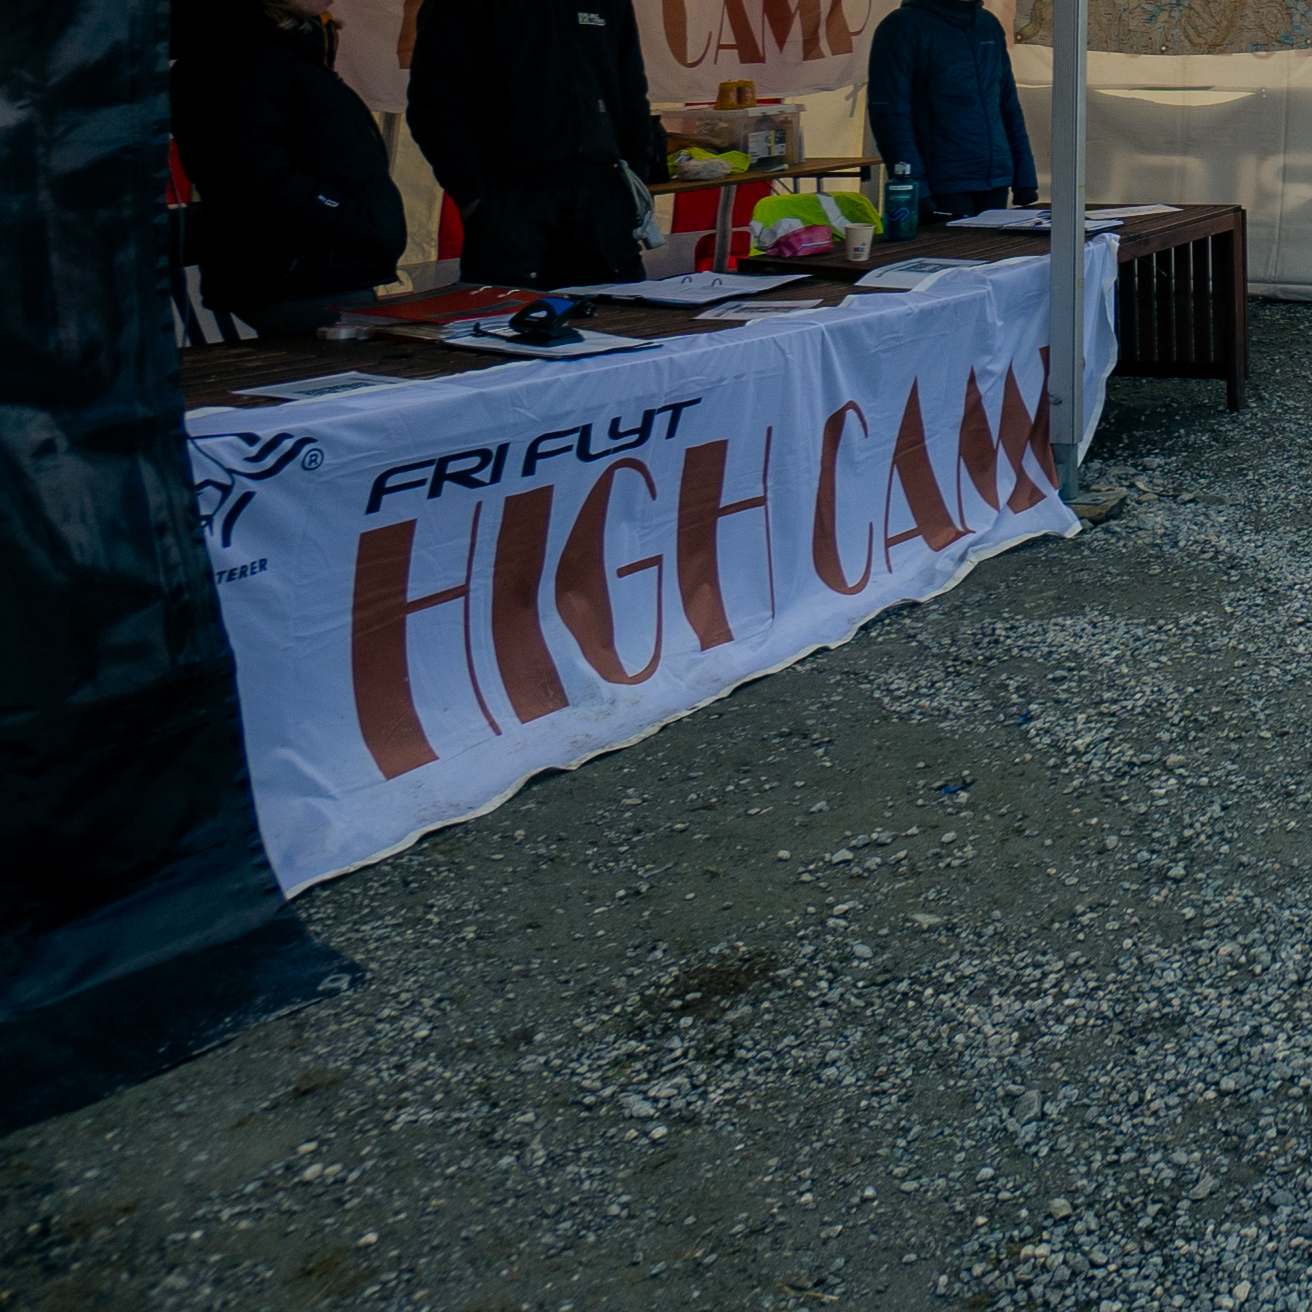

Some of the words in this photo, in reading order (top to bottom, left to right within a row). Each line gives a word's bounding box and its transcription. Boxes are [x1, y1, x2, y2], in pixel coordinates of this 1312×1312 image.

[365, 442, 508, 515] FRI
[522, 397, 701, 479] FLYT
[216, 557, 268, 585] TERER
[350, 426, 776, 780] HIGH
